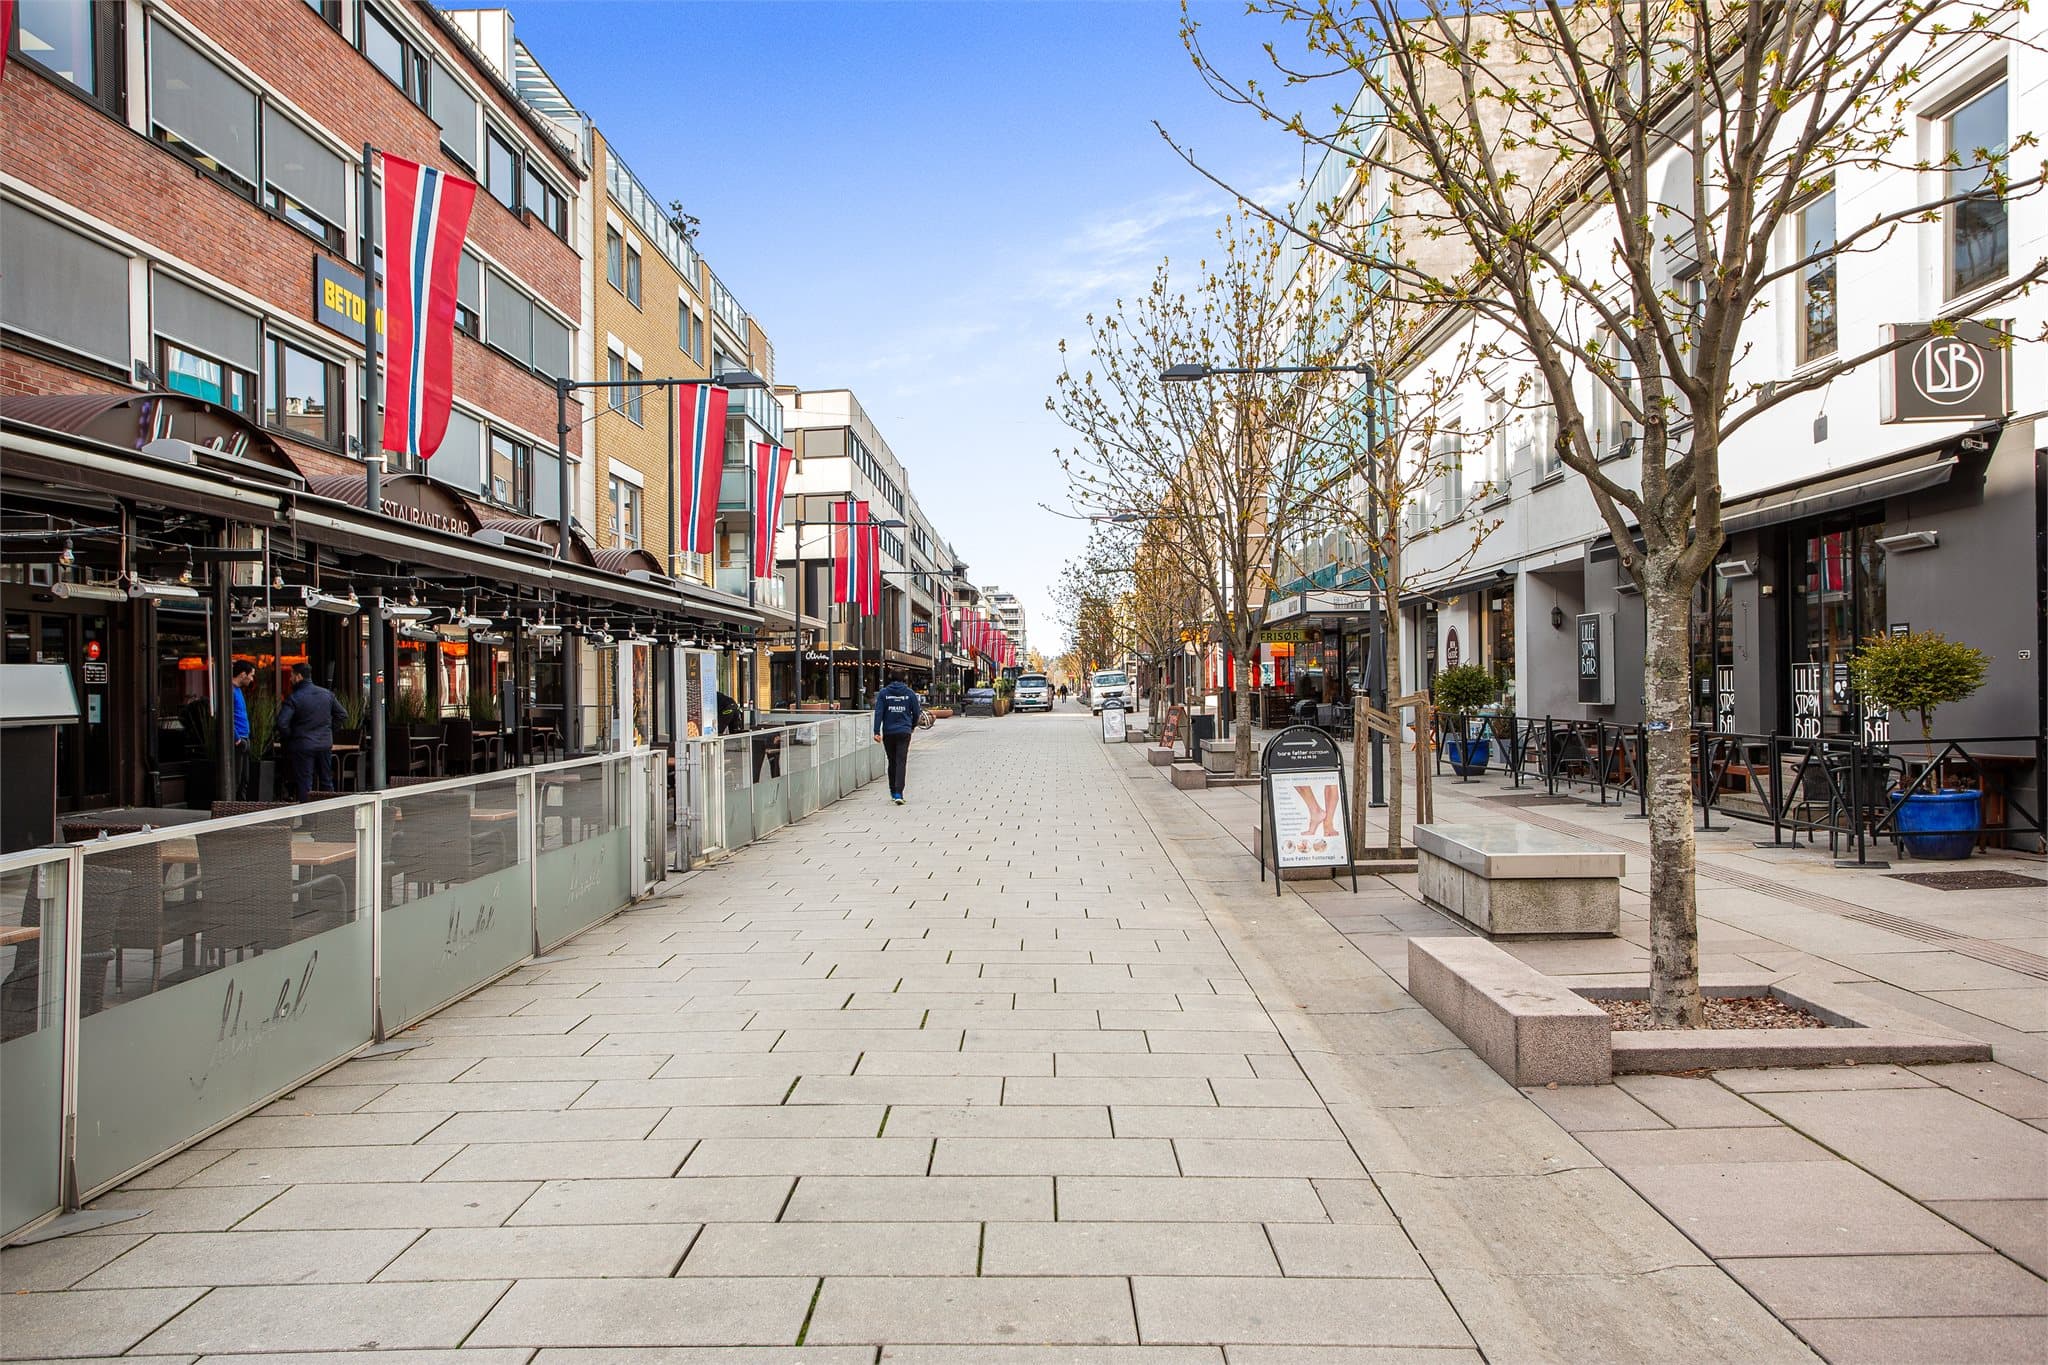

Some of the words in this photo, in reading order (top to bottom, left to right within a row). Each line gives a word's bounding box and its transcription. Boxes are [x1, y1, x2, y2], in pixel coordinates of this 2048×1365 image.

[379, 498, 440, 529] ESTAURANT
[450, 518, 469, 537] BAR
[1260, 632, 1300, 641] FRISØR
[1581, 658, 1597, 675] BAR
[1719, 669, 1735, 692] LILL
[1794, 668, 1820, 693] LILLE
[1719, 714, 1736, 734] BA
[1795, 717, 1821, 740] BAR
